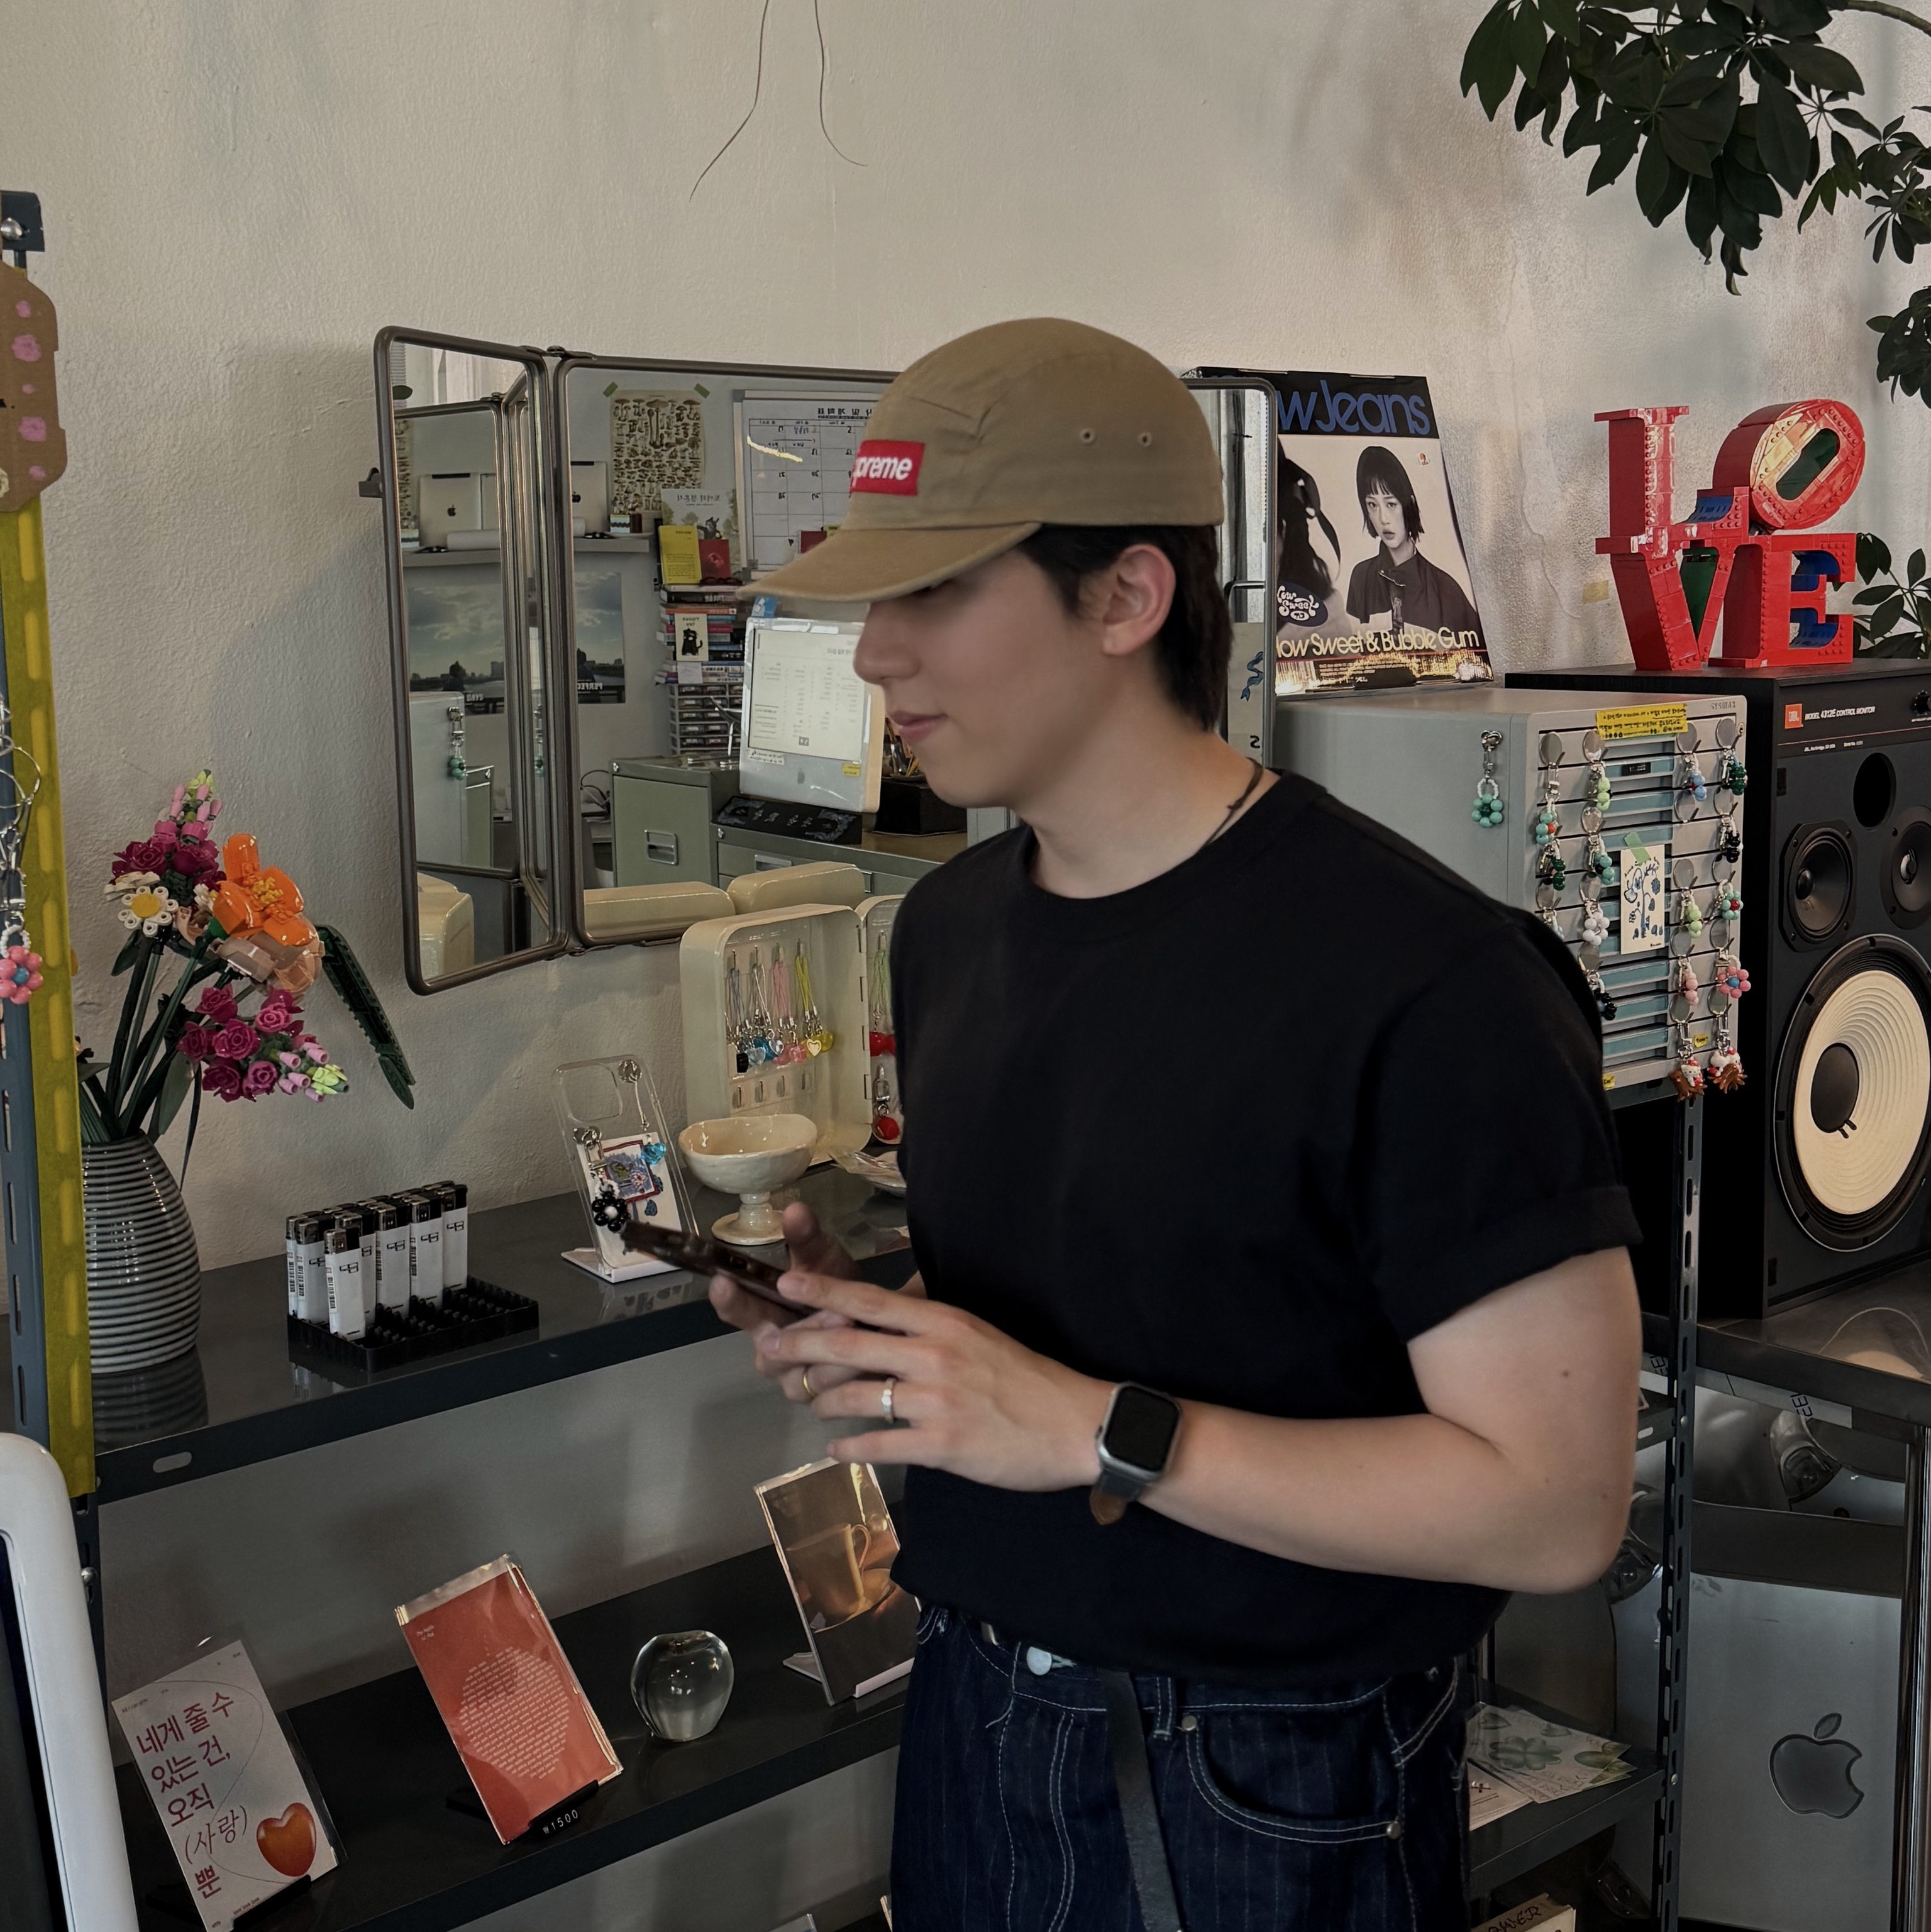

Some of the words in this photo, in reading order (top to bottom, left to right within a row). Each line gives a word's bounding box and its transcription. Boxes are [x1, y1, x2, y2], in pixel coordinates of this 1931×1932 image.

[1278, 379, 1430, 435] wJeans
[1310, 629, 1363, 654] Sweet
[1366, 631, 1382, 653] &
[1381, 627, 1437, 652] Bubble
[1437, 626, 1480, 649] Gum
[136, 1714, 185, 1756] 네게
[183, 1703, 210, 1734] 줄
[212, 1691, 234, 1718] 수
[151, 1757, 200, 1794] 있는
[199, 1735, 231, 1769] 건,
[167, 1782, 216, 1828] 오직
[184, 1804, 248, 1867] (사랑)
[194, 1865, 222, 1900] 뿐
